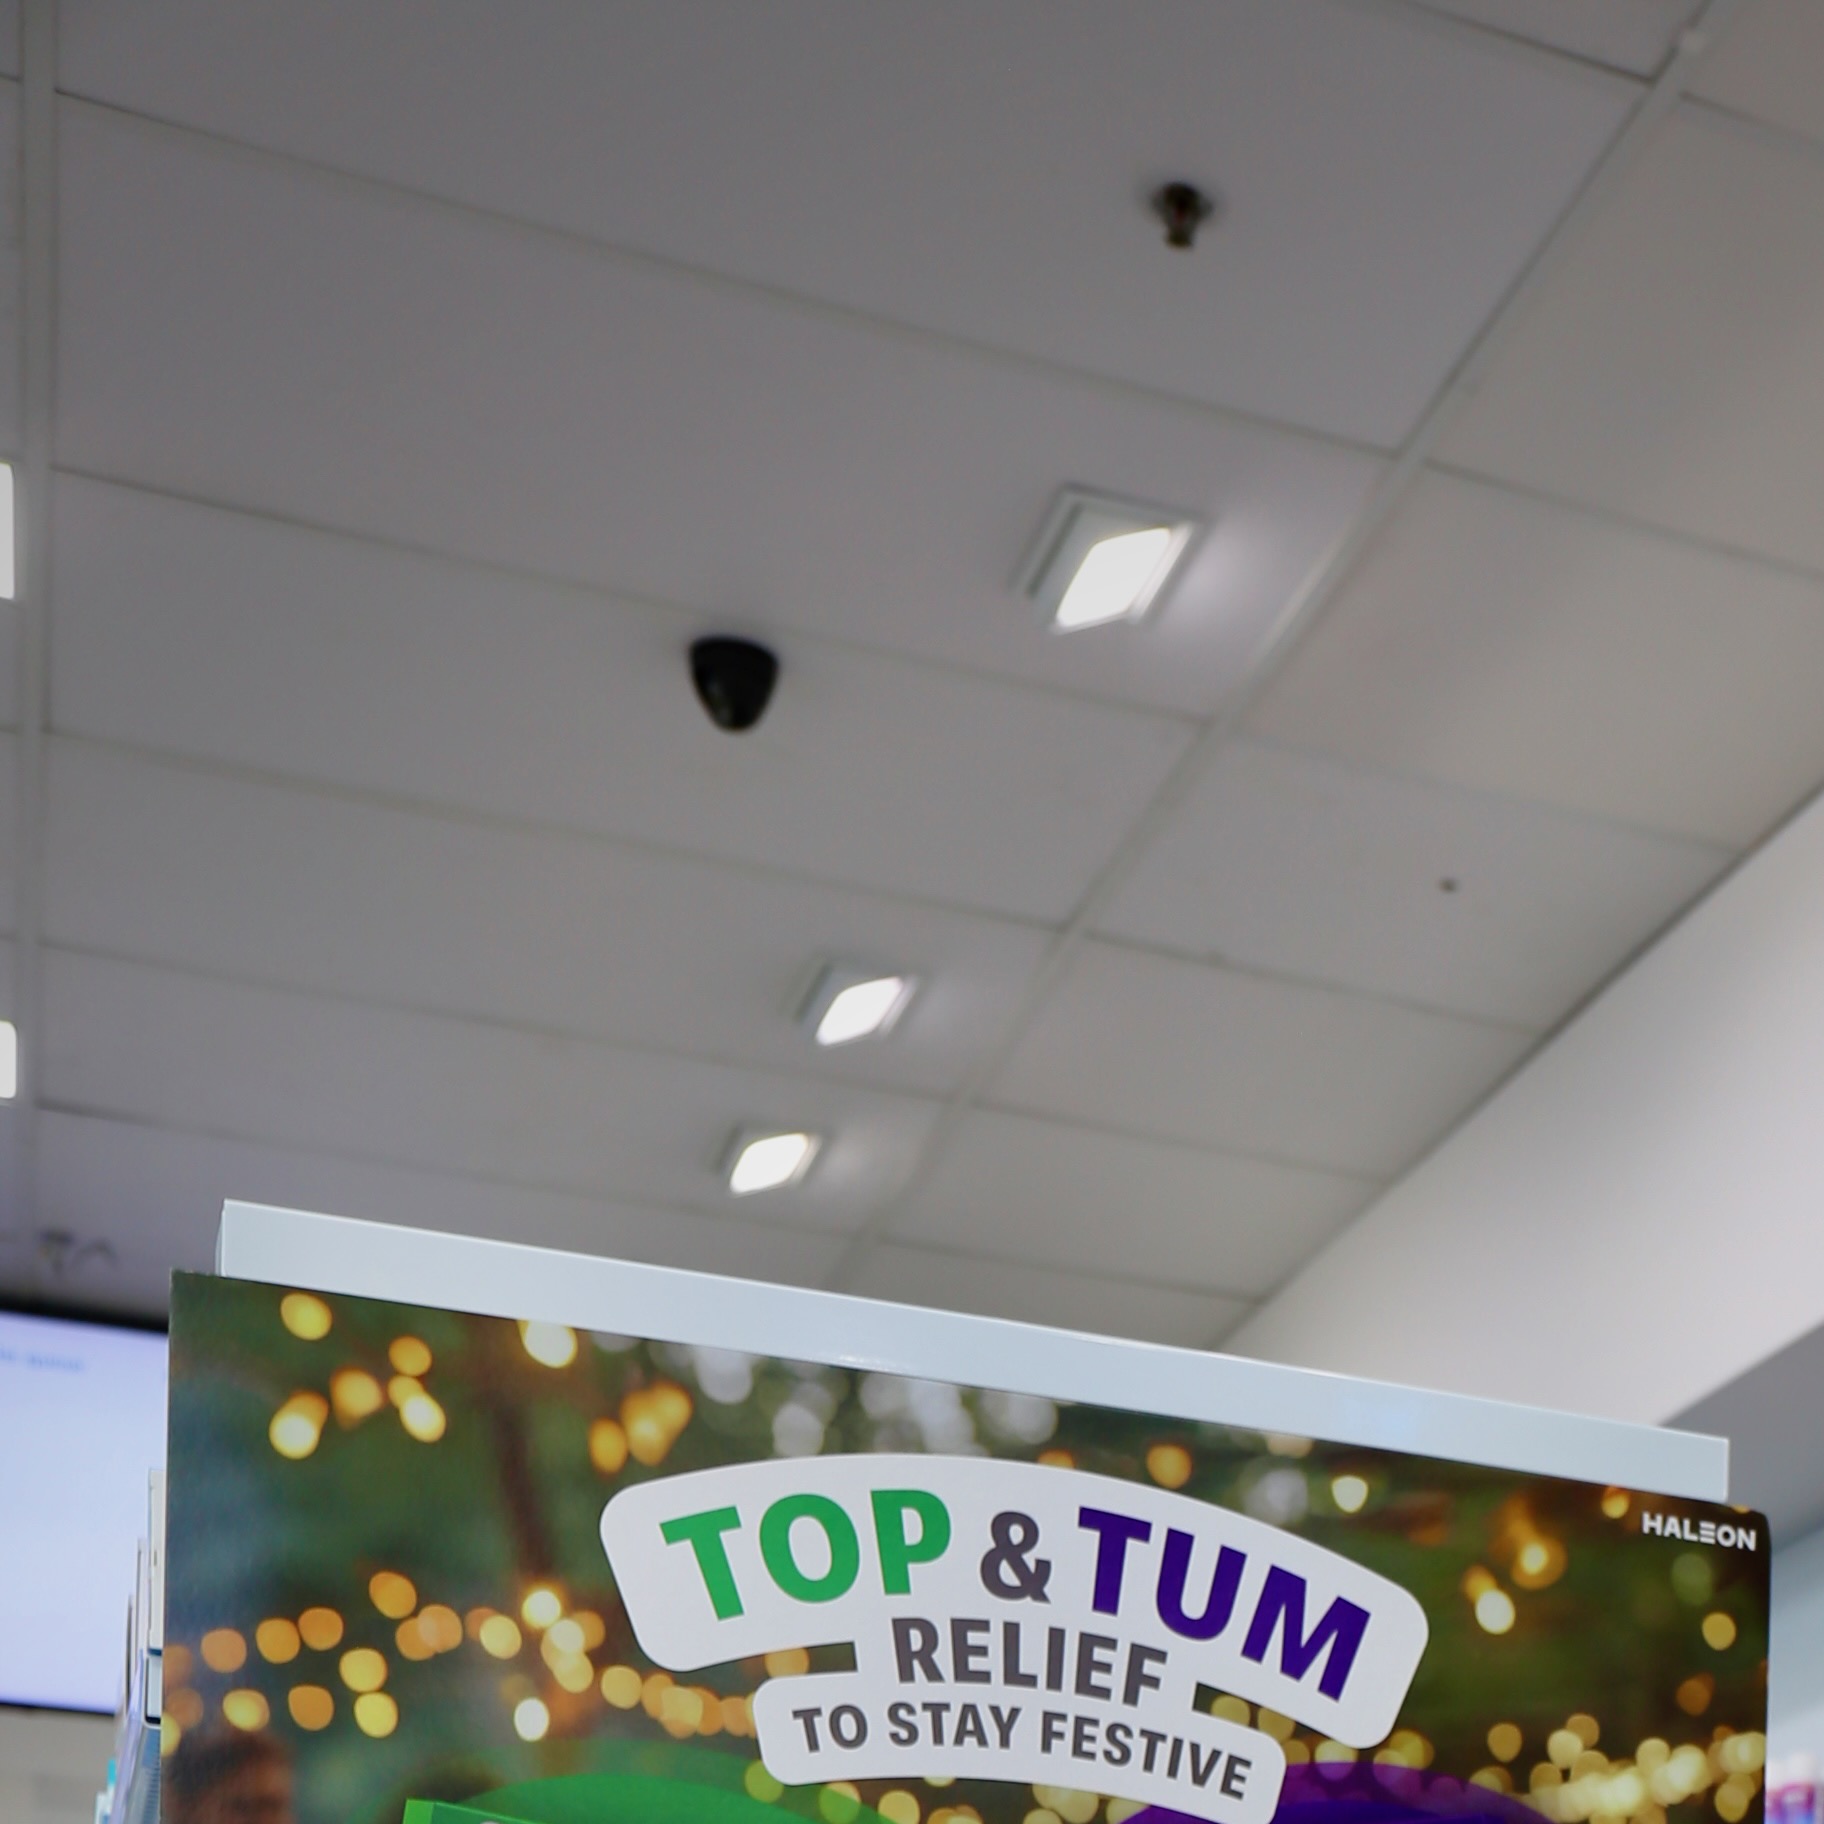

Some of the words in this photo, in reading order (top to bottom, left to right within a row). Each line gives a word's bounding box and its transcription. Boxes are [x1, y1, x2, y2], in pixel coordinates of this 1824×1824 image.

[1642, 1512, 1757, 1551] HALEON
[659, 1489, 952, 1620] TOP
[980, 1512, 1051, 1602] &
[1078, 1506, 1371, 1701] TUM
[892, 1617, 1168, 1708] RELIEF
[793, 1705, 868, 1753] TO
[888, 1702, 1021, 1748] STAY
[1042, 1709, 1253, 1801] FESTIVE
